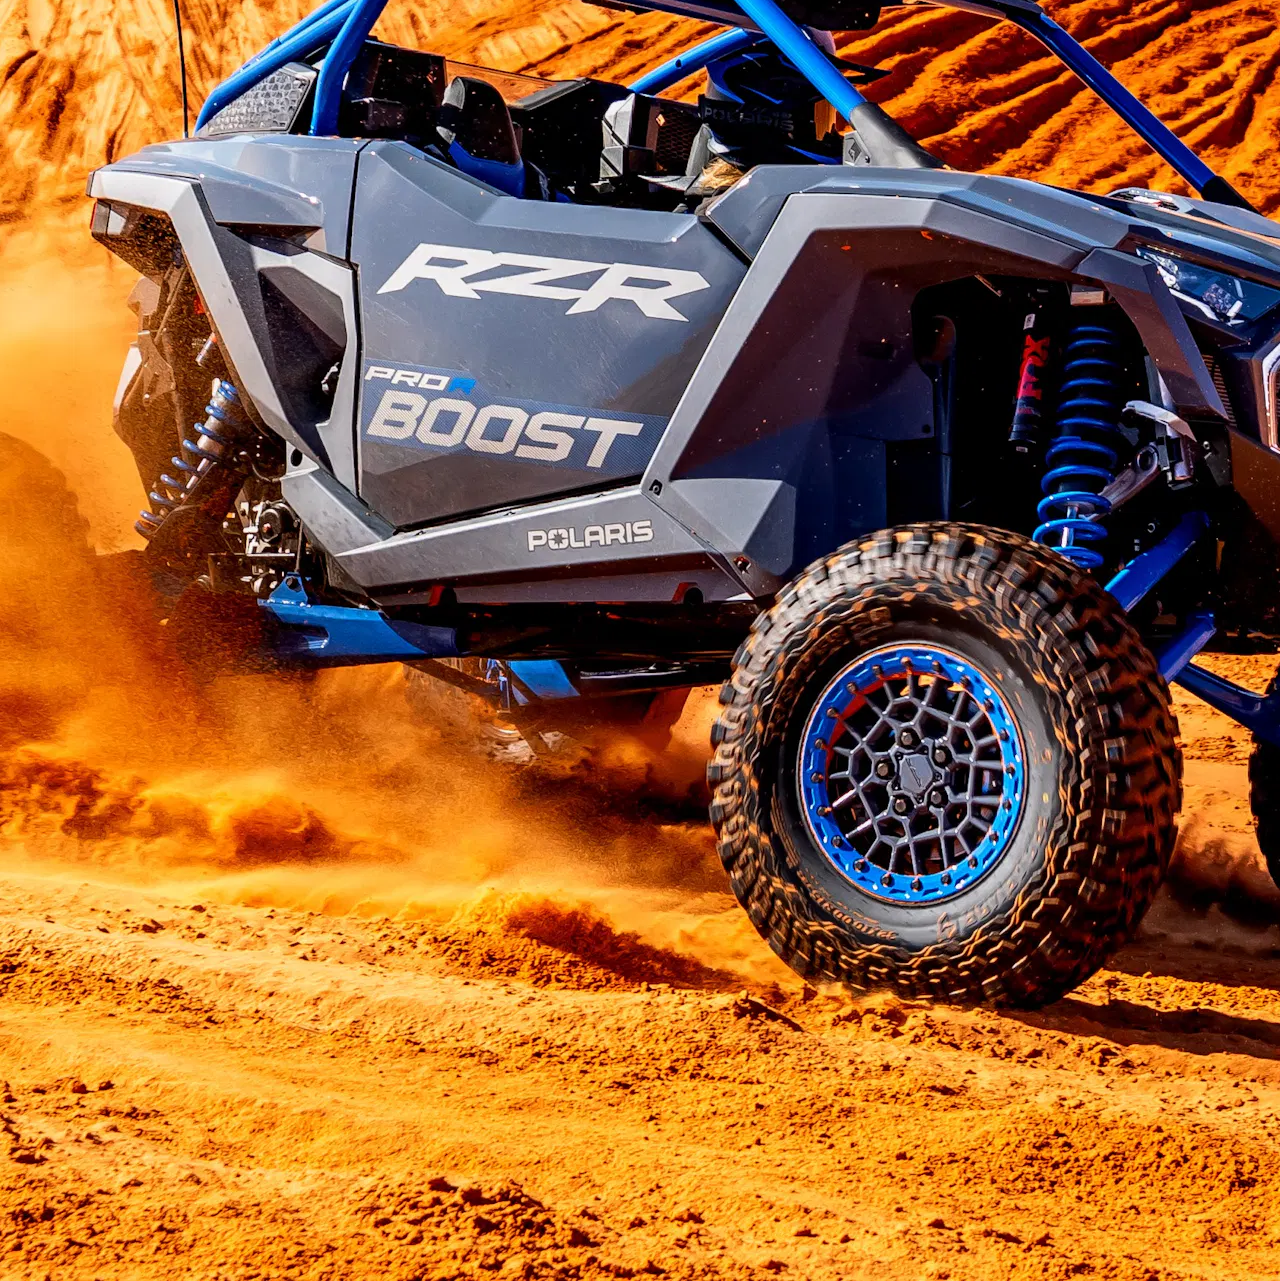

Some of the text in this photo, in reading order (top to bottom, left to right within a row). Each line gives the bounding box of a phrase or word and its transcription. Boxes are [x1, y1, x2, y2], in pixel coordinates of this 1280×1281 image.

[376, 242, 711, 322] RZR
[366, 389, 644, 468] BOOST
[527, 520, 654, 552] POLARIS
